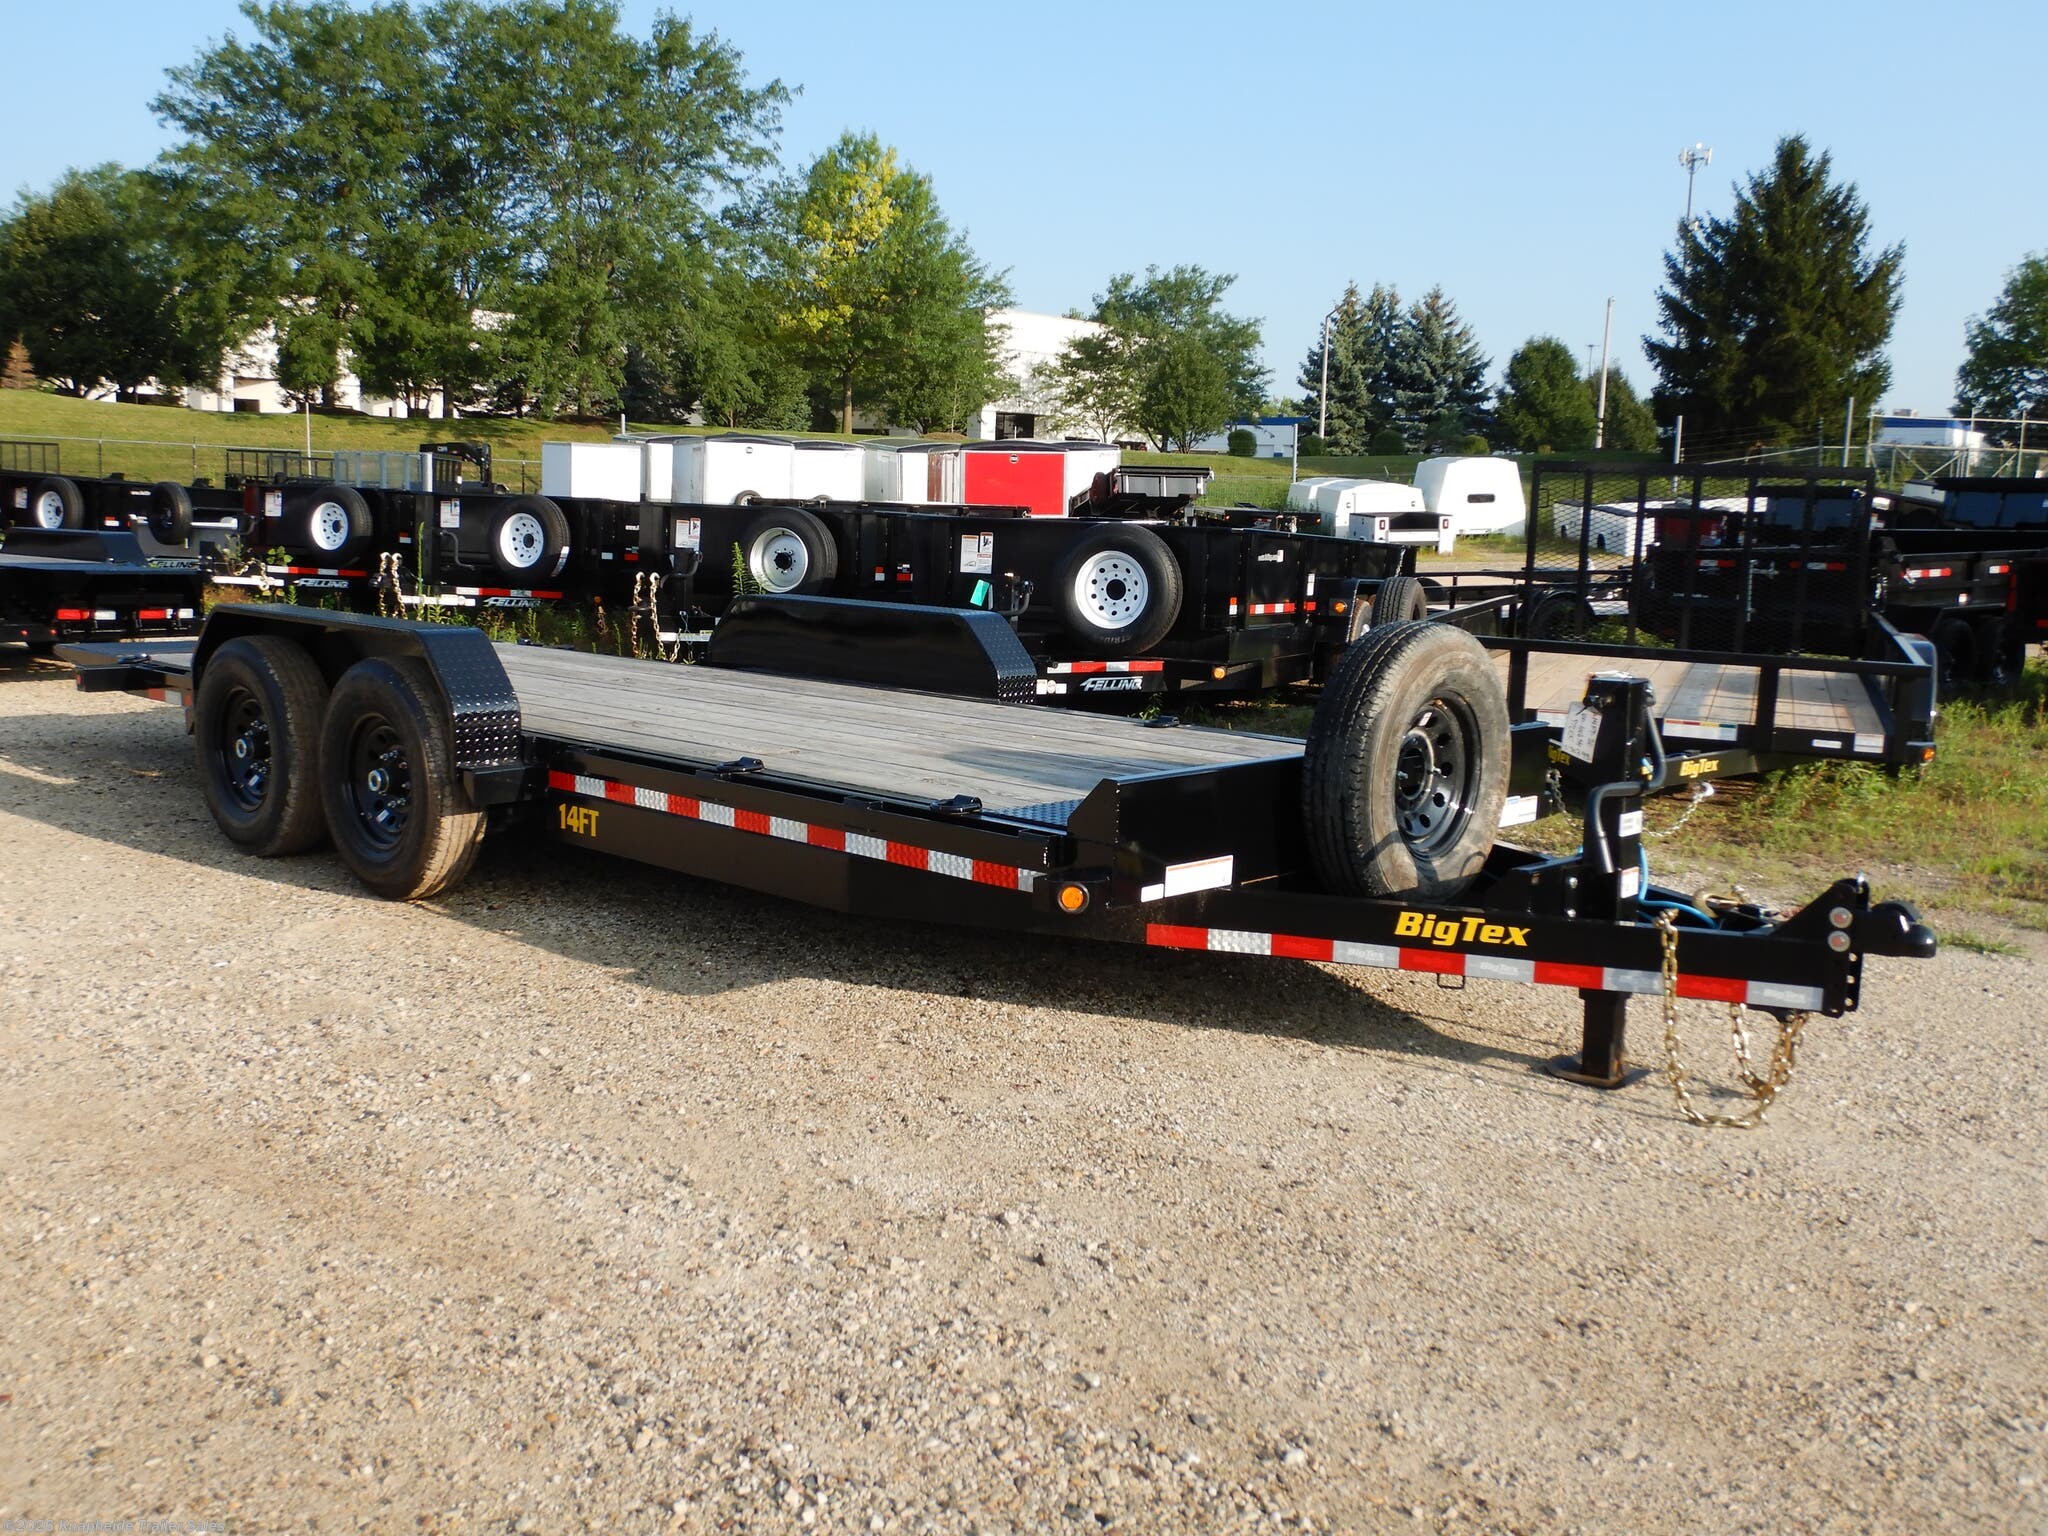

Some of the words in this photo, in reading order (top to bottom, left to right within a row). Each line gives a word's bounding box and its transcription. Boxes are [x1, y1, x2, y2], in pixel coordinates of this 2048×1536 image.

[1080, 675, 1144, 692] FELLING
[1679, 758, 1720, 778] BigTex
[558, 802, 600, 837] 14FT
[1394, 911, 1531, 947] BigTex
